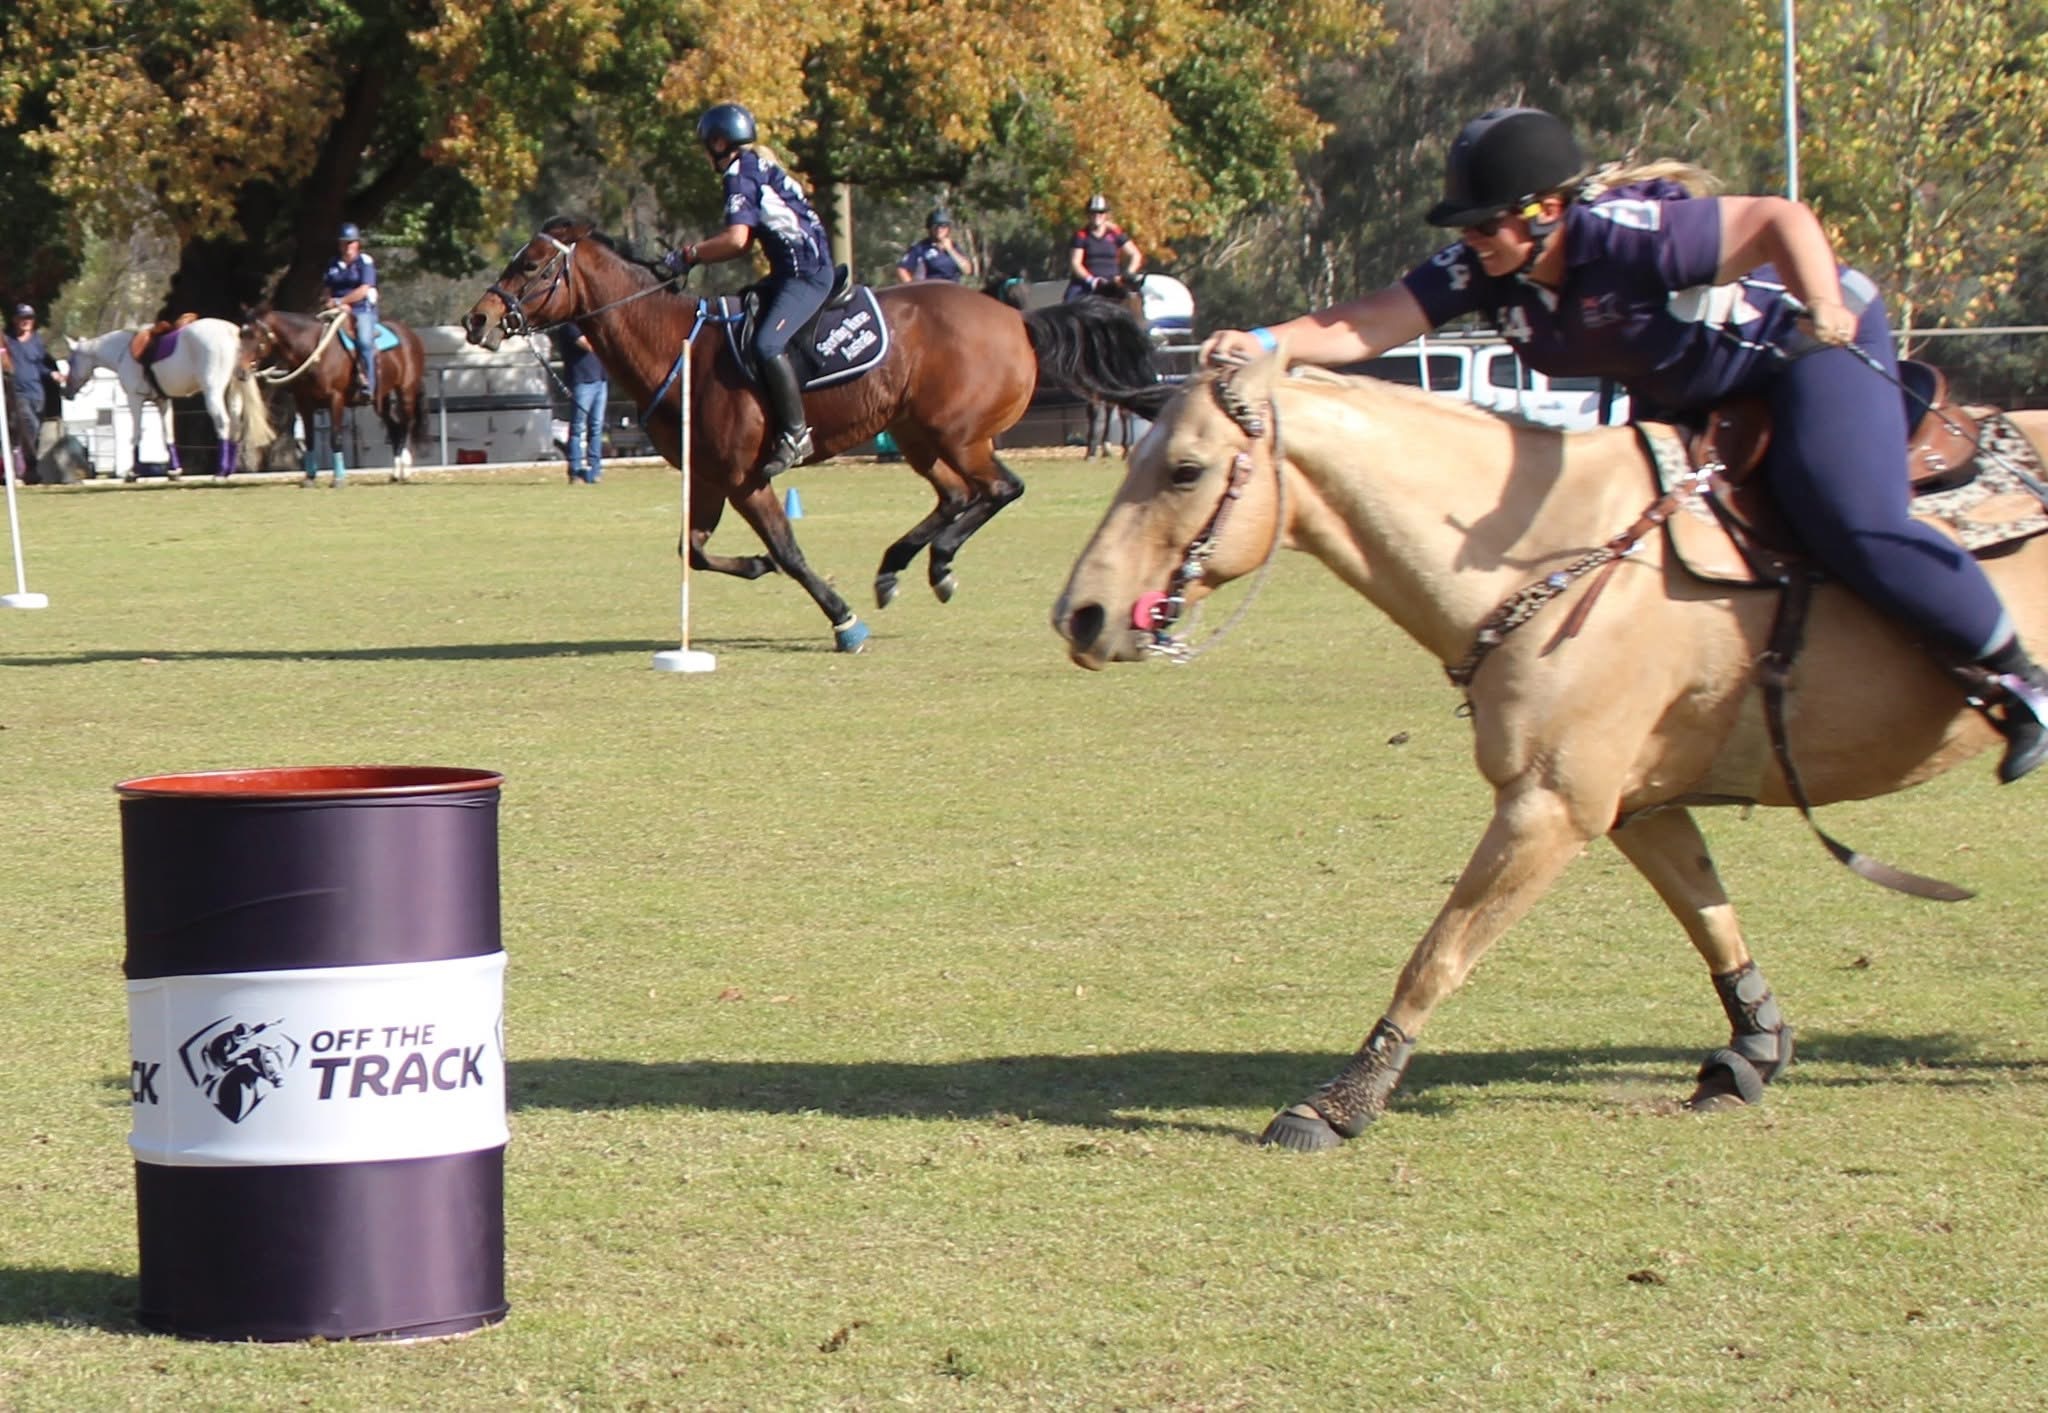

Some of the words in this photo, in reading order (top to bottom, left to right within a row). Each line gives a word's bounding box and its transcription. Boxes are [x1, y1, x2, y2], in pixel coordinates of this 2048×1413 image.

[310, 1030, 374, 1053] OFF
[381, 1024, 435, 1049] THE
[310, 1044, 486, 1100] TRACK
